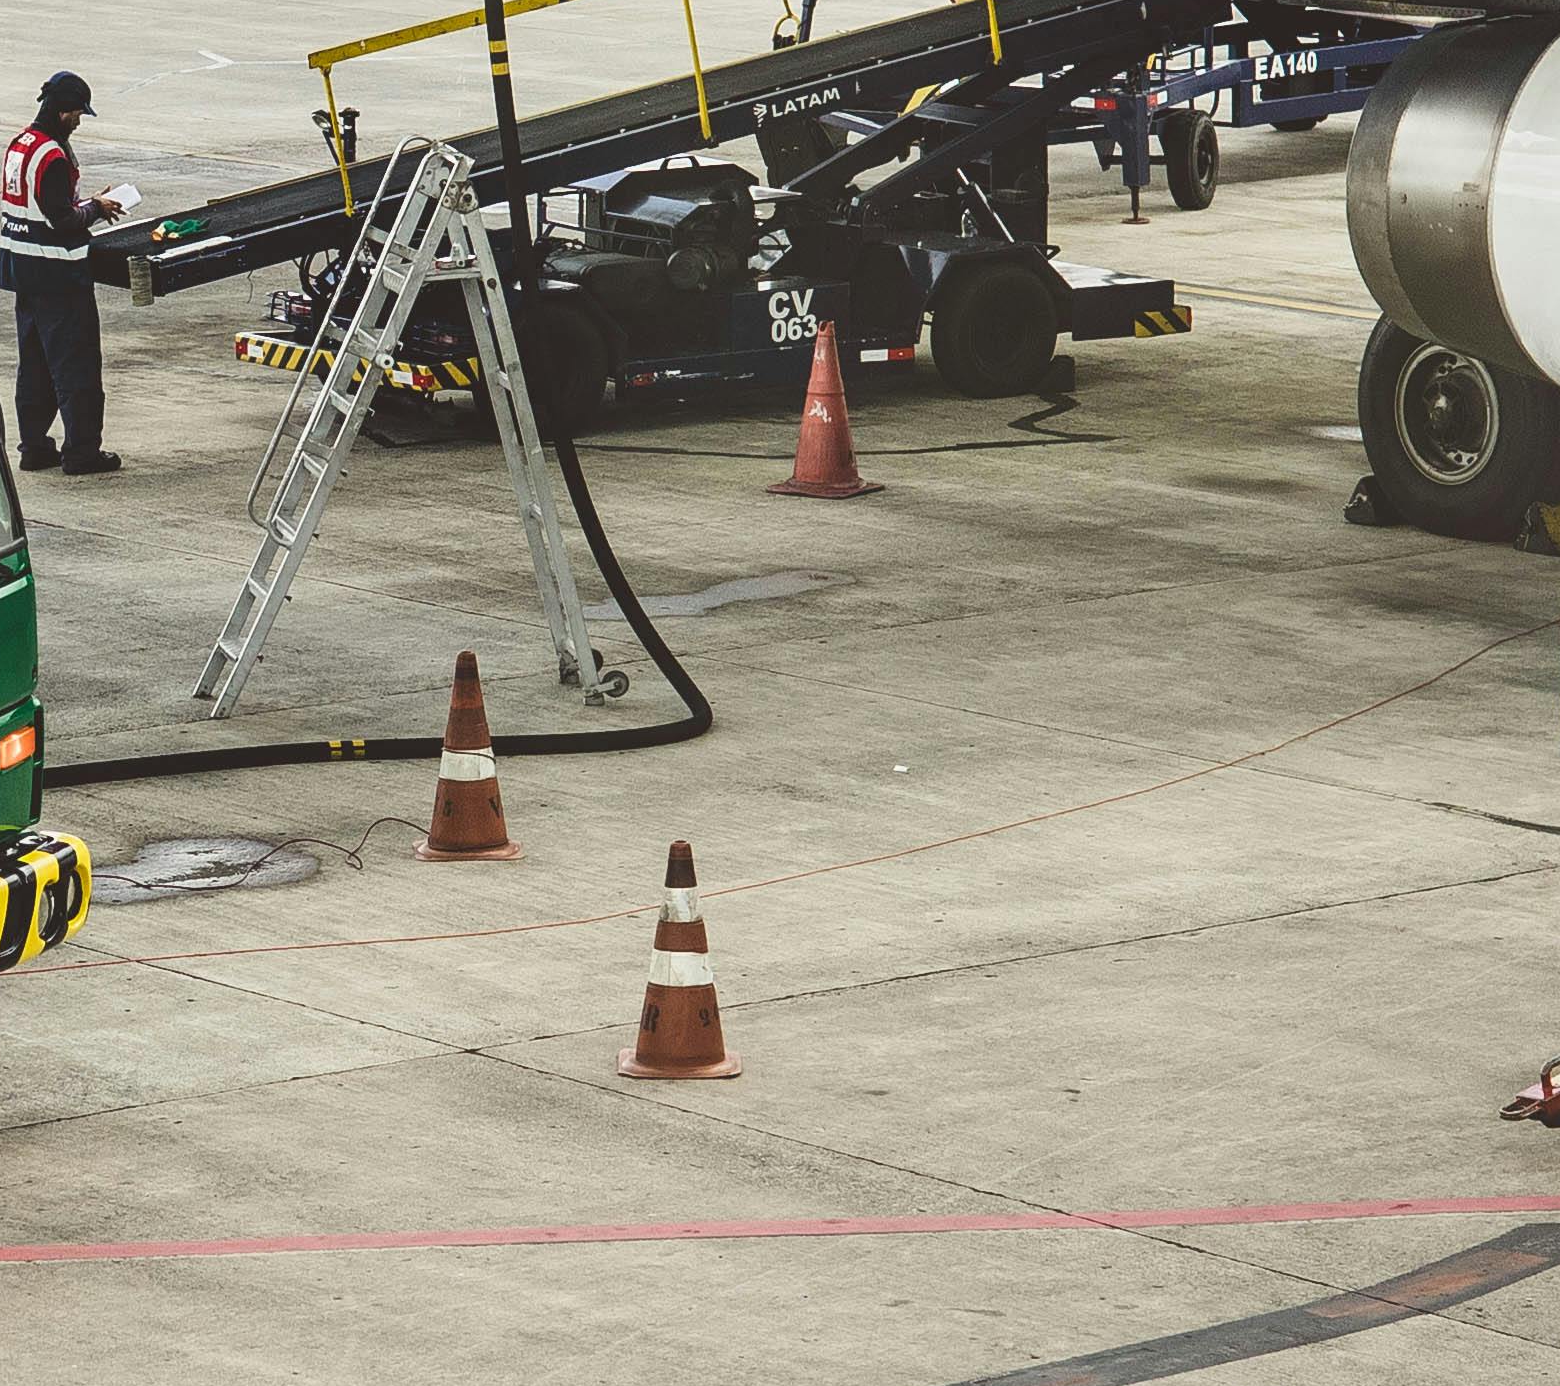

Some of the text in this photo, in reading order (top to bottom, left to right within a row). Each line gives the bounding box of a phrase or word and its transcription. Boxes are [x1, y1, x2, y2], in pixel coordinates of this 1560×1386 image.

[771, 87, 841, 118] LATAM
[768, 288, 814, 319] CV
[771, 314, 818, 343] 063
